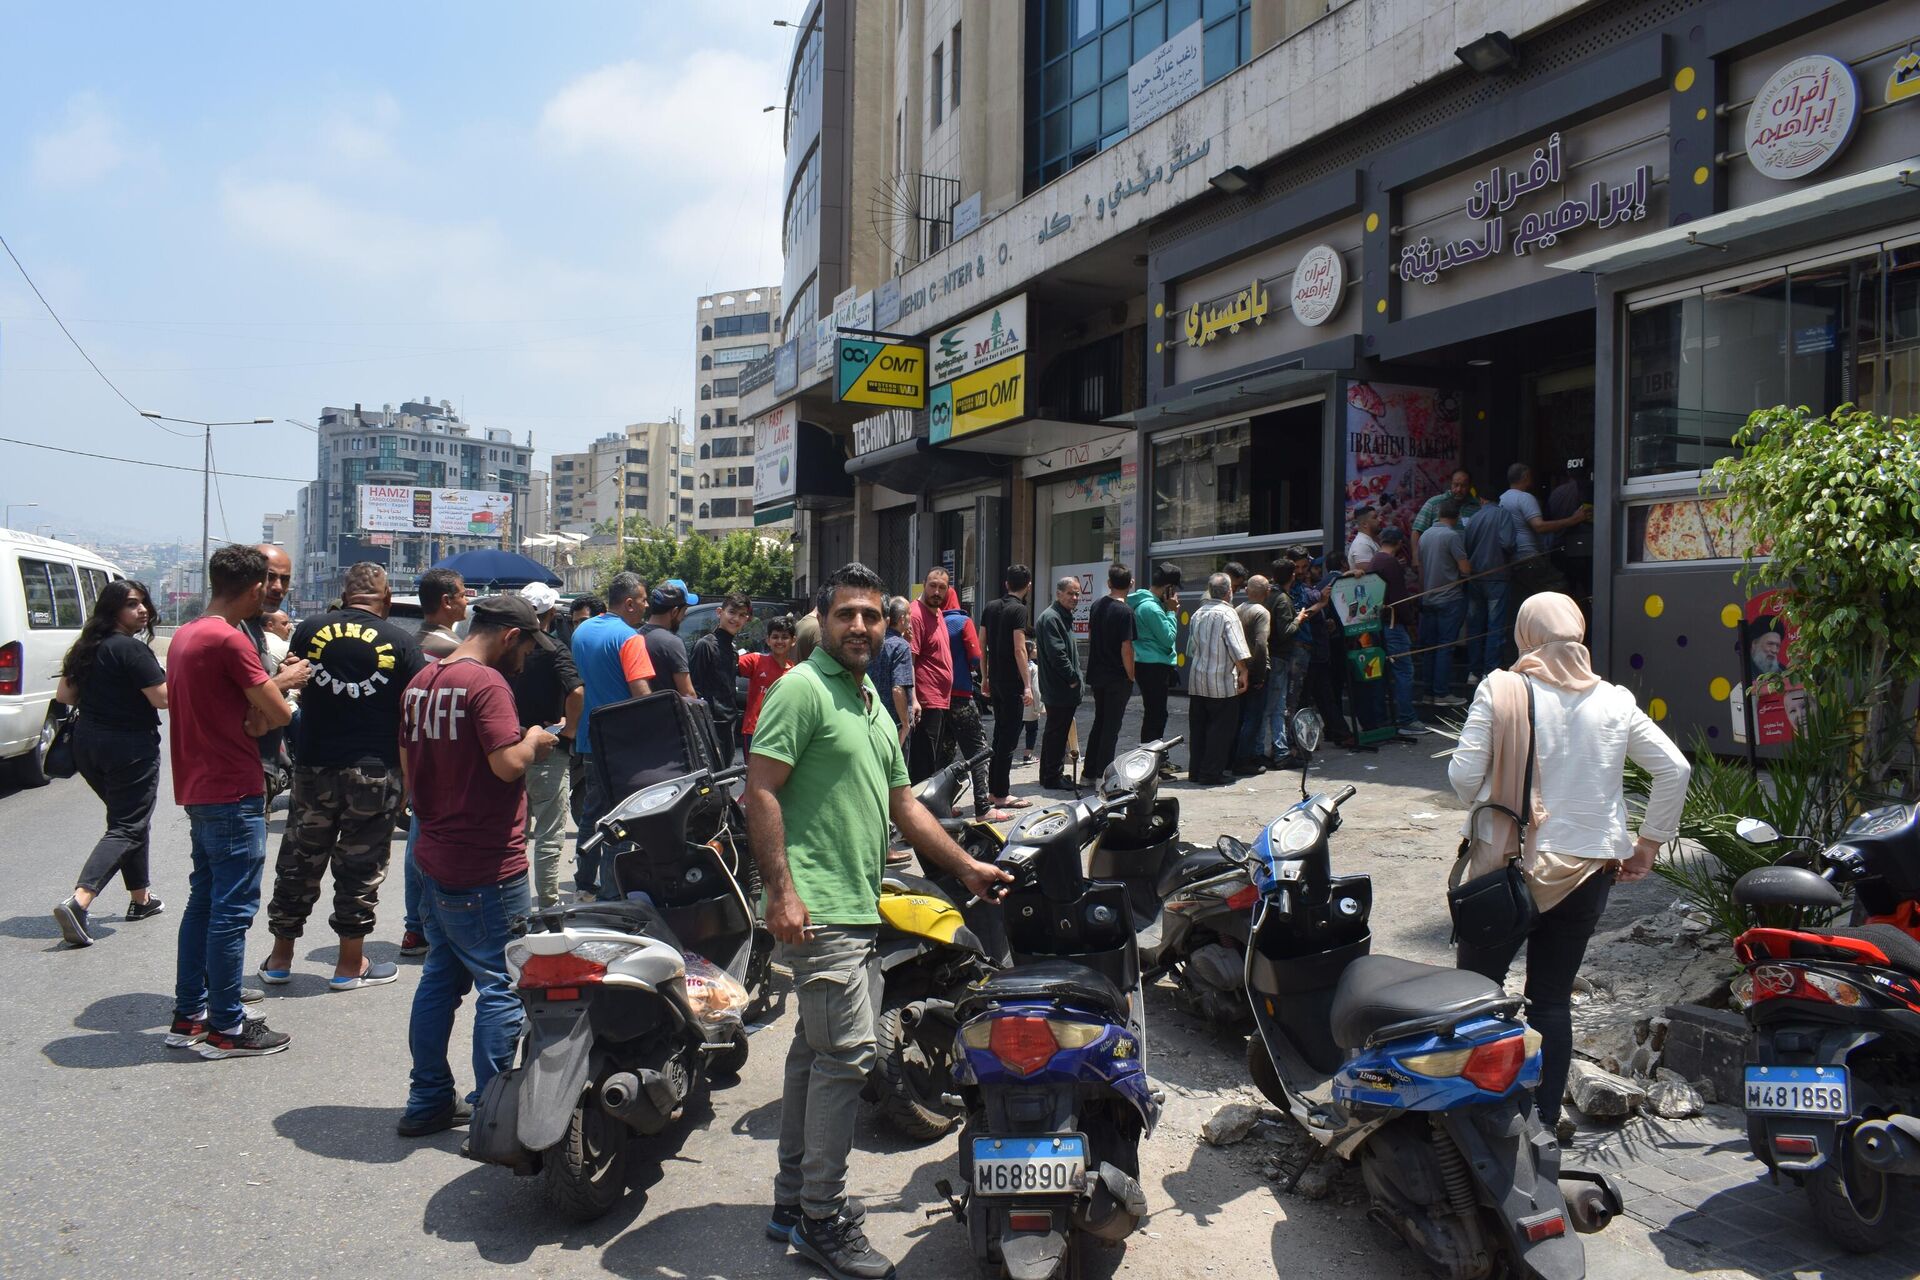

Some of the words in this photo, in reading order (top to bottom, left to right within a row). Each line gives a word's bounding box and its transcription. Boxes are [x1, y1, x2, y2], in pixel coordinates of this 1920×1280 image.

[1772, 66, 1831, 117] أفران
[1751, 97, 1837, 149] إبراهيم
[1466, 132, 1562, 220] أفران
[1513, 165, 1647, 257] إبراهيم
[1399, 216, 1503, 284] الحديثة
[1304, 254, 1332, 284] أفران
[1294, 275, 1334, 303] إبراهيم
[1184, 279, 1268, 348] باتيسيري
[973, 329, 1020, 359] MEA
[880, 355, 919, 373] OMT
[868, 381, 898, 389] WESTERN
[877, 386, 898, 394] UNION
[990, 375, 1021, 407] OMT
[768, 406, 784, 429] FAST
[853, 410, 891, 456] TECHNO
[892, 409, 913, 444] YAD
[773, 424, 790, 445] LANE
[369, 486, 409, 499] HAMZI
[307, 622, 378, 660] LIVING
[376, 643, 396, 669] IN
[309, 661, 389, 699] LEGACY
[403, 687, 468, 742] STAFF
[1747, 1085, 1842, 1109] M481858
